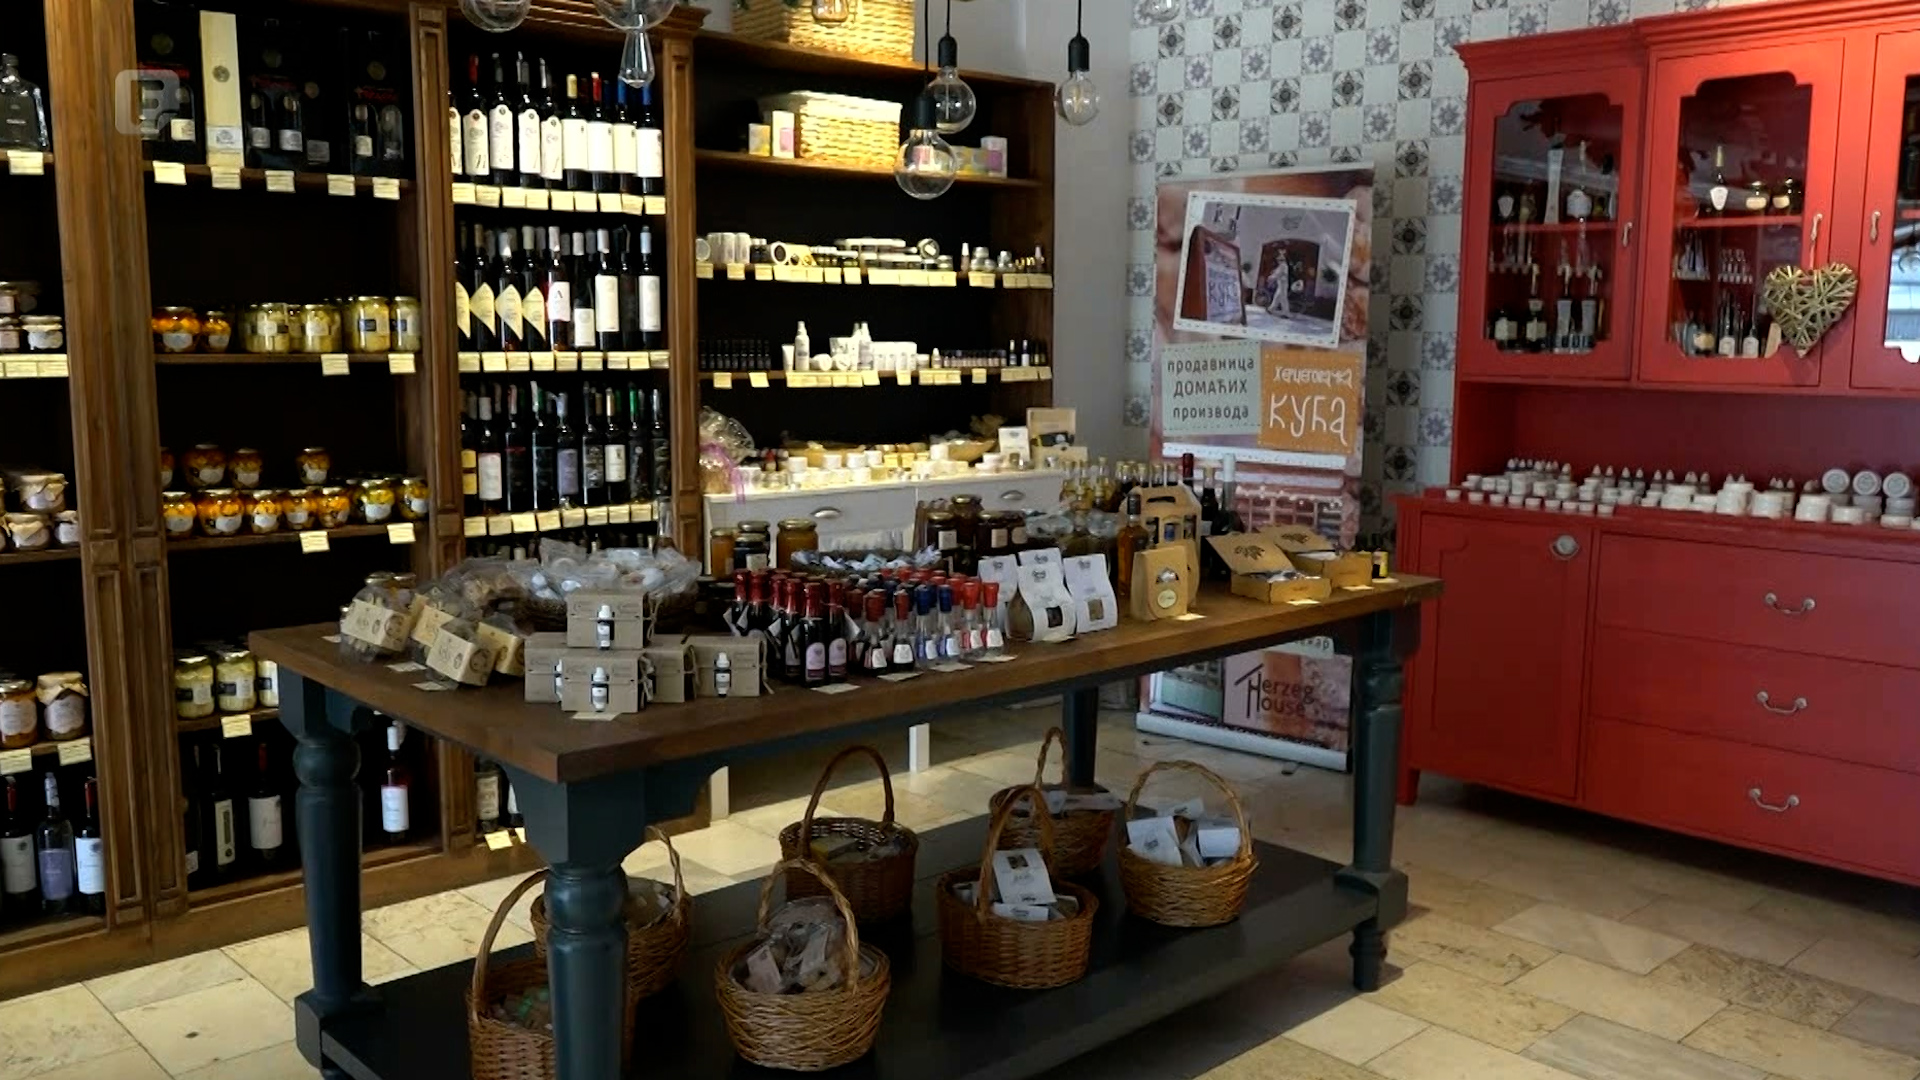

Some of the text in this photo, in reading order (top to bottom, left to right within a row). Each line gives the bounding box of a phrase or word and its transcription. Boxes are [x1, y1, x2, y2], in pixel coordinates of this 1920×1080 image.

[1167, 358, 1255, 375] продавница
[1173, 379, 1248, 398] ДОМАЋИХ
[1173, 405, 1249, 421] производа
